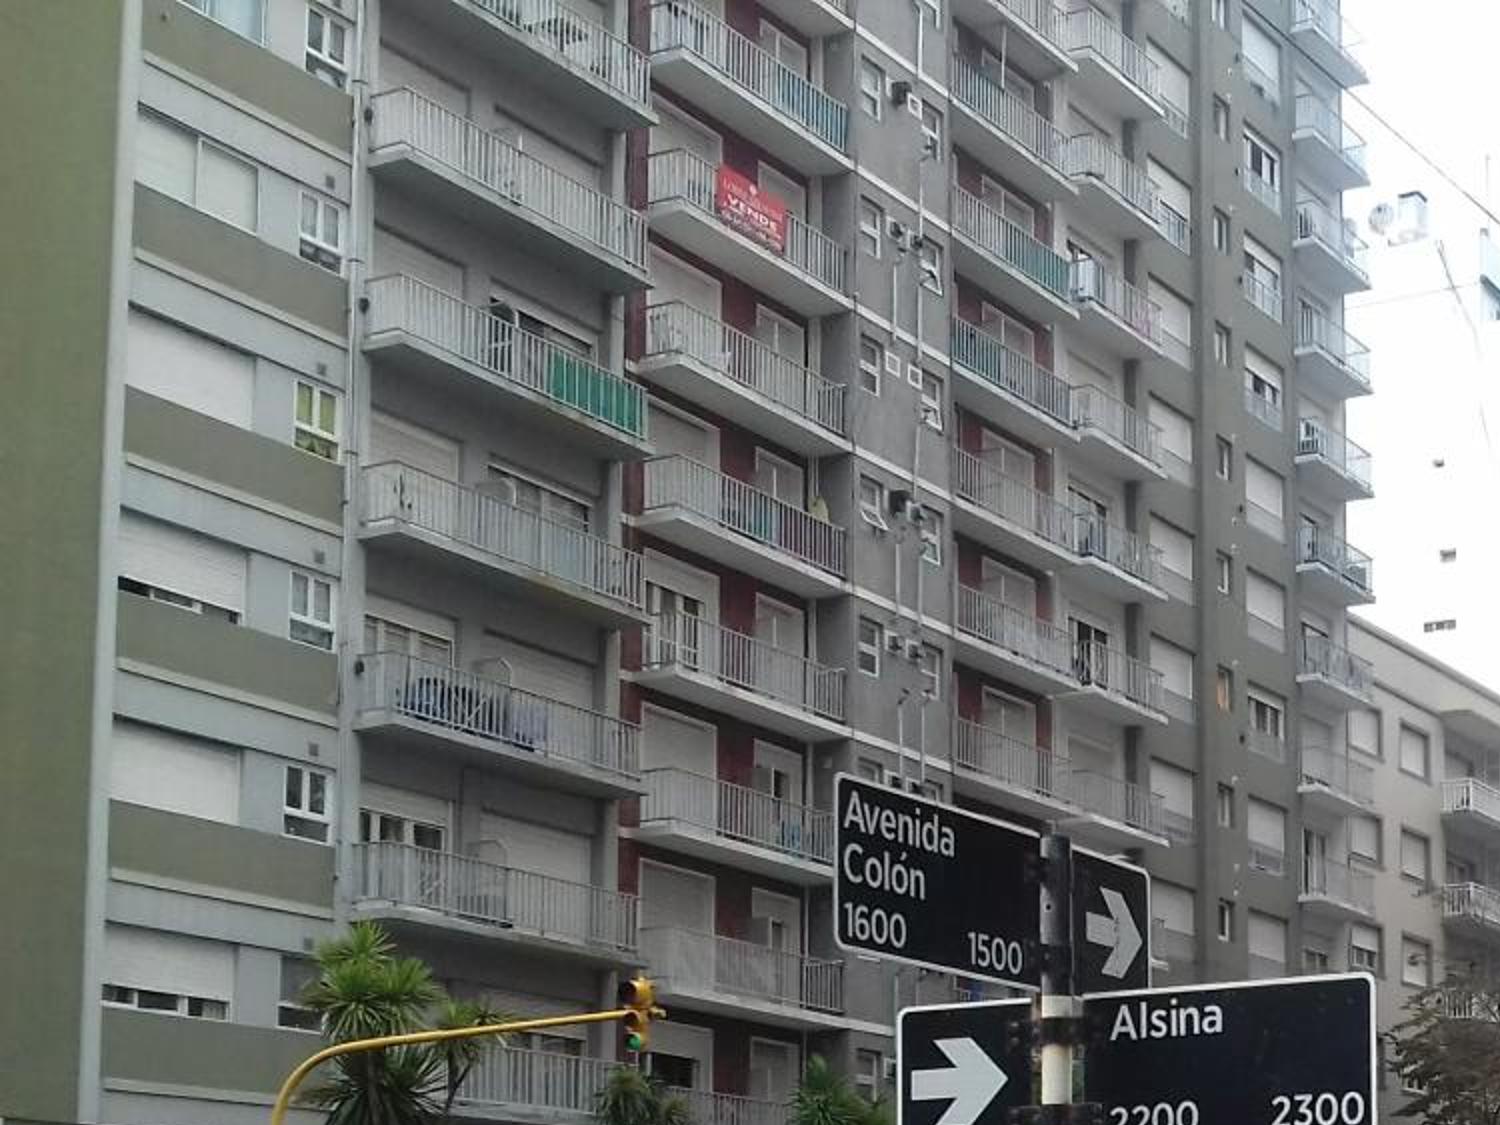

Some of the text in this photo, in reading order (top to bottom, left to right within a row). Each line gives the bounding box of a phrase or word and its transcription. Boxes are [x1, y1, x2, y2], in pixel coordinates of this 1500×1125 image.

[727, 193, 778, 232] VENDE
[844, 790, 955, 857] Avenida
[844, 843, 925, 900] Colón
[843, 902, 1023, 974] 1600 1500
[1110, 998, 1223, 1041] Alsina
